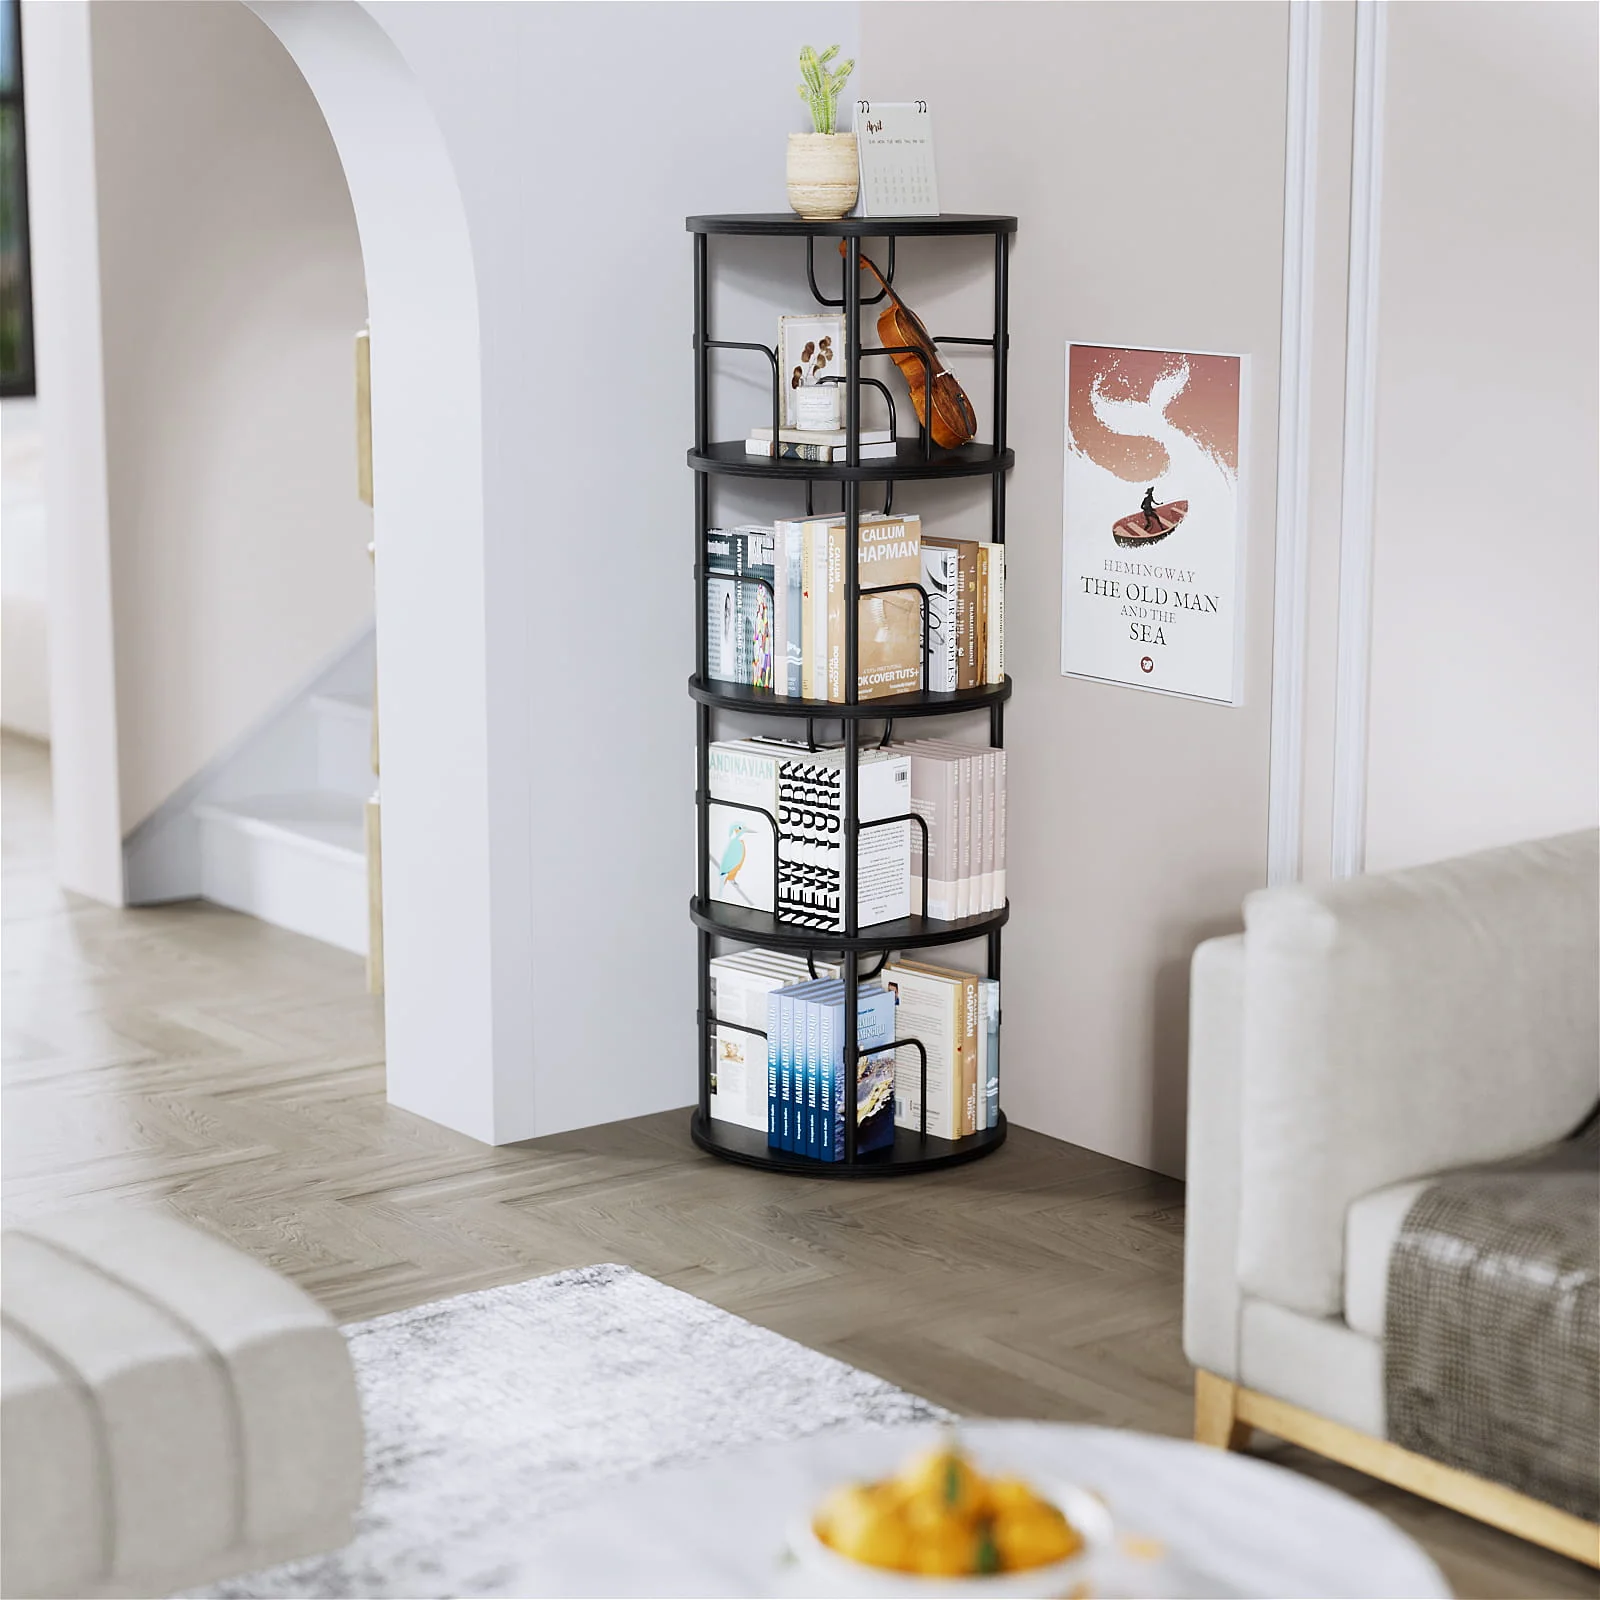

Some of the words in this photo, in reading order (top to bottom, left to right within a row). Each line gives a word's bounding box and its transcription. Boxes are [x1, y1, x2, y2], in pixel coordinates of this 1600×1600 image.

[866, 120, 883, 134] April
[859, 540, 918, 564] HAPMAN
[862, 525, 905, 542] CALLUM
[1080, 576, 1121, 598] THE
[1126, 583, 1168, 605] OLD
[1174, 592, 1220, 613] MAN
[1103, 559, 1196, 583] HEMINGWAY
[1120, 604, 1148, 619] AND
[1152, 610, 1176, 623] THE
[1129, 622, 1167, 646] SEA
[858, 675, 869, 686] OK
[869, 671, 895, 684] COVER
[896, 667, 919, 679] TUTS+
[710, 754, 773, 780] ANDINAVIAN
[779, 761, 791, 840] YORK
[791, 763, 803, 843] YORK
[803, 765, 815, 845] YORK
[815, 767, 827, 848] YORK
[827, 769, 840, 850] YORK
[779, 859, 791, 922] NEW
[791, 861, 803, 925] NEW
[803, 864, 815, 927] NEW
[815, 866, 827, 929] NEW
[827, 868, 840, 932] NEW
[966, 985, 974, 1037] CHAPMAN
